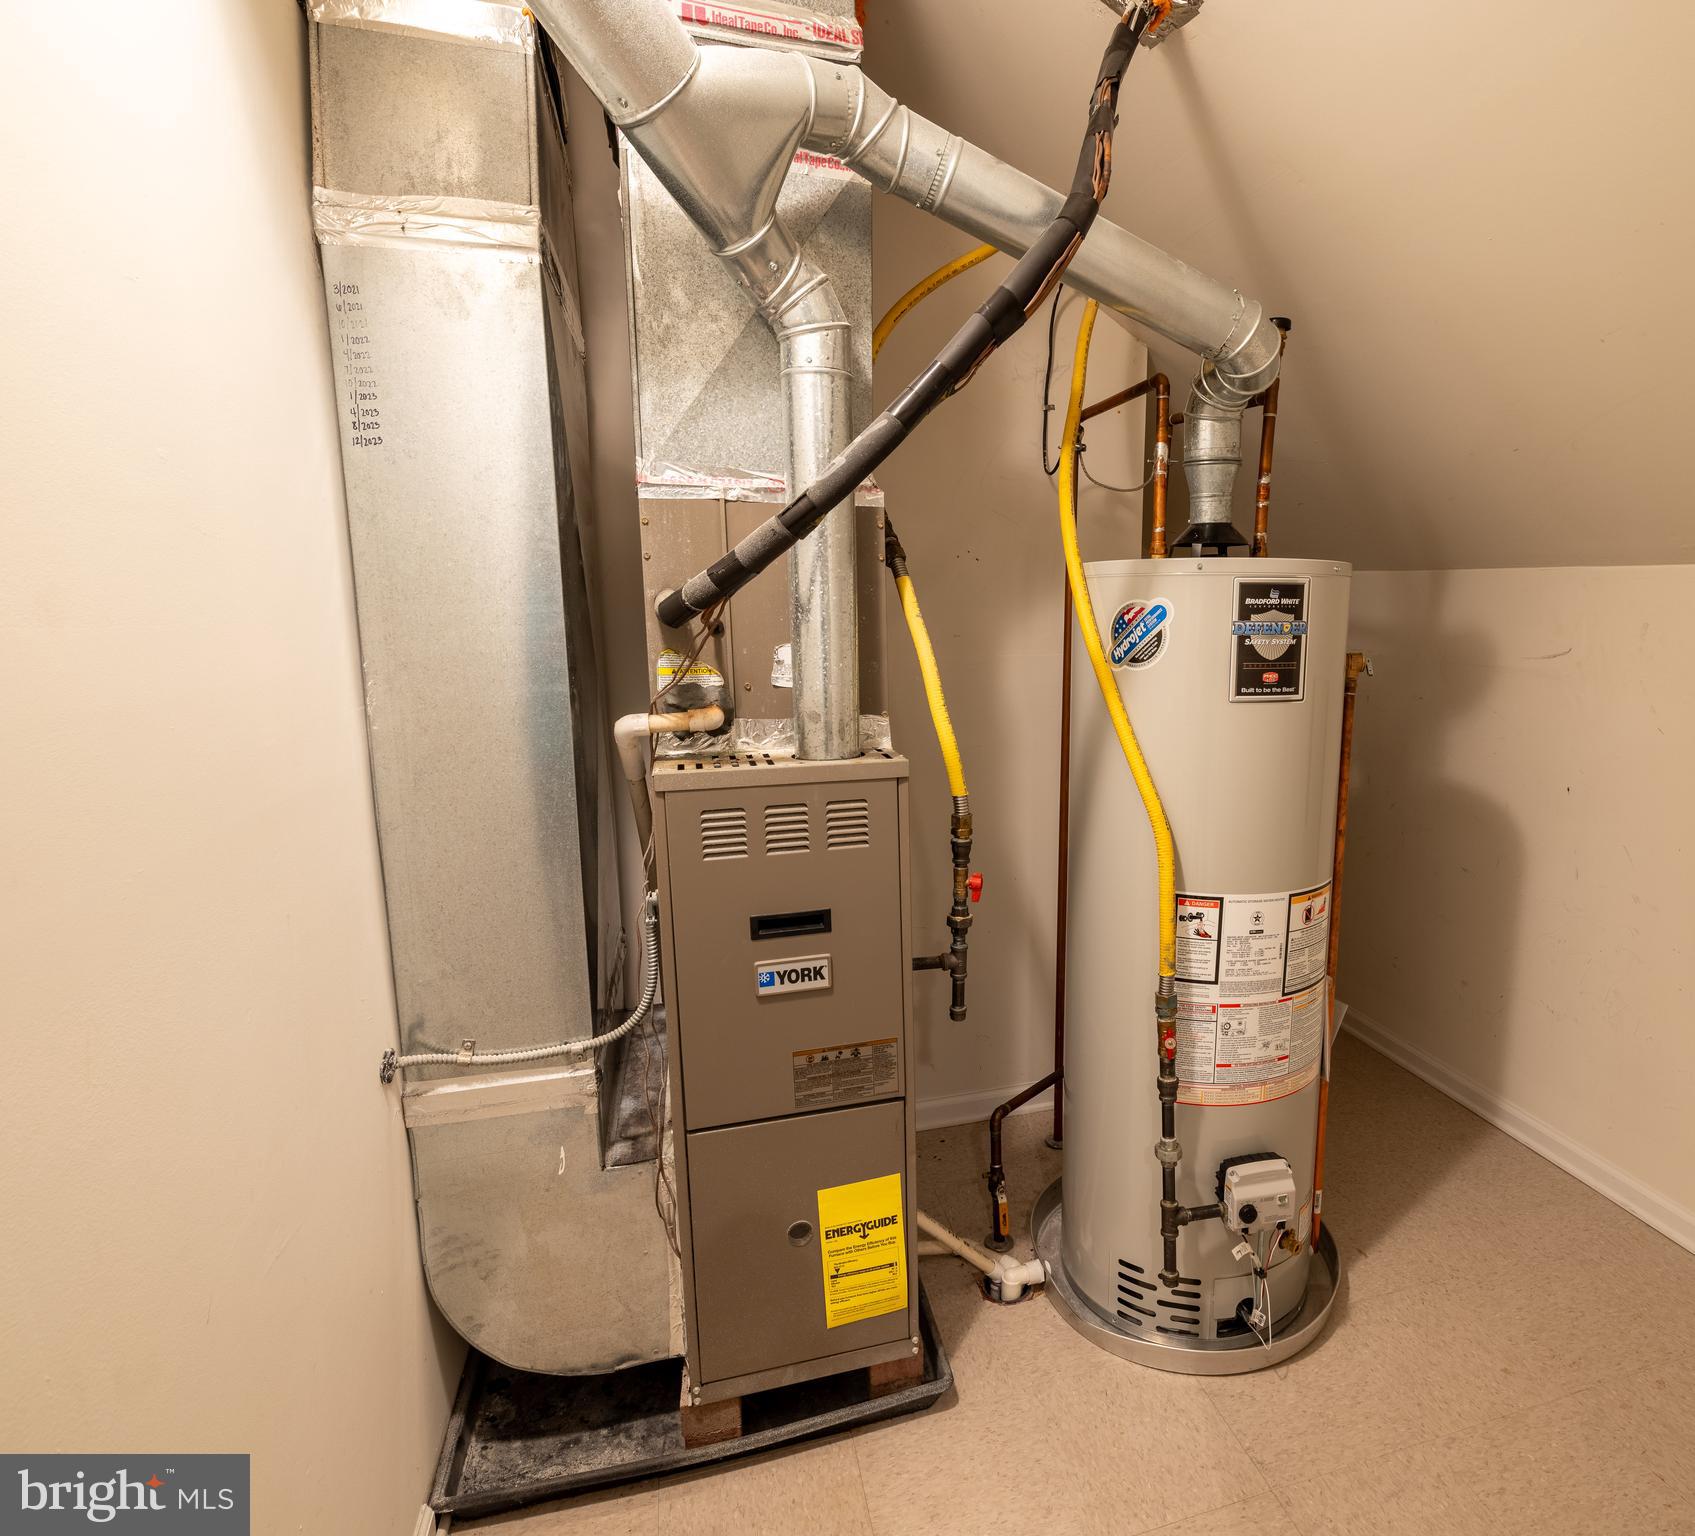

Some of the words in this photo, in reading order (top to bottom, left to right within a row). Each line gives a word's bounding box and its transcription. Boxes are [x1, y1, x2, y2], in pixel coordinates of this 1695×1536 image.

[333, 281, 360, 297] 3/2021
[349, 390, 378, 405] 1/2023
[350, 403, 380, 419] 4/2023
[351, 418, 381, 433] 8/2023
[352, 434, 384, 448] 12/2023
[1232, 620, 1308, 636] DEFENDER
[1112, 620, 1148, 660] Hydrojet
[1244, 638, 1270, 646] SAFETY
[1271, 638, 1298, 646] SYSTEM
[775, 965, 826, 986] YORK
[825, 1214, 898, 1240] ENERGYGUIDE
